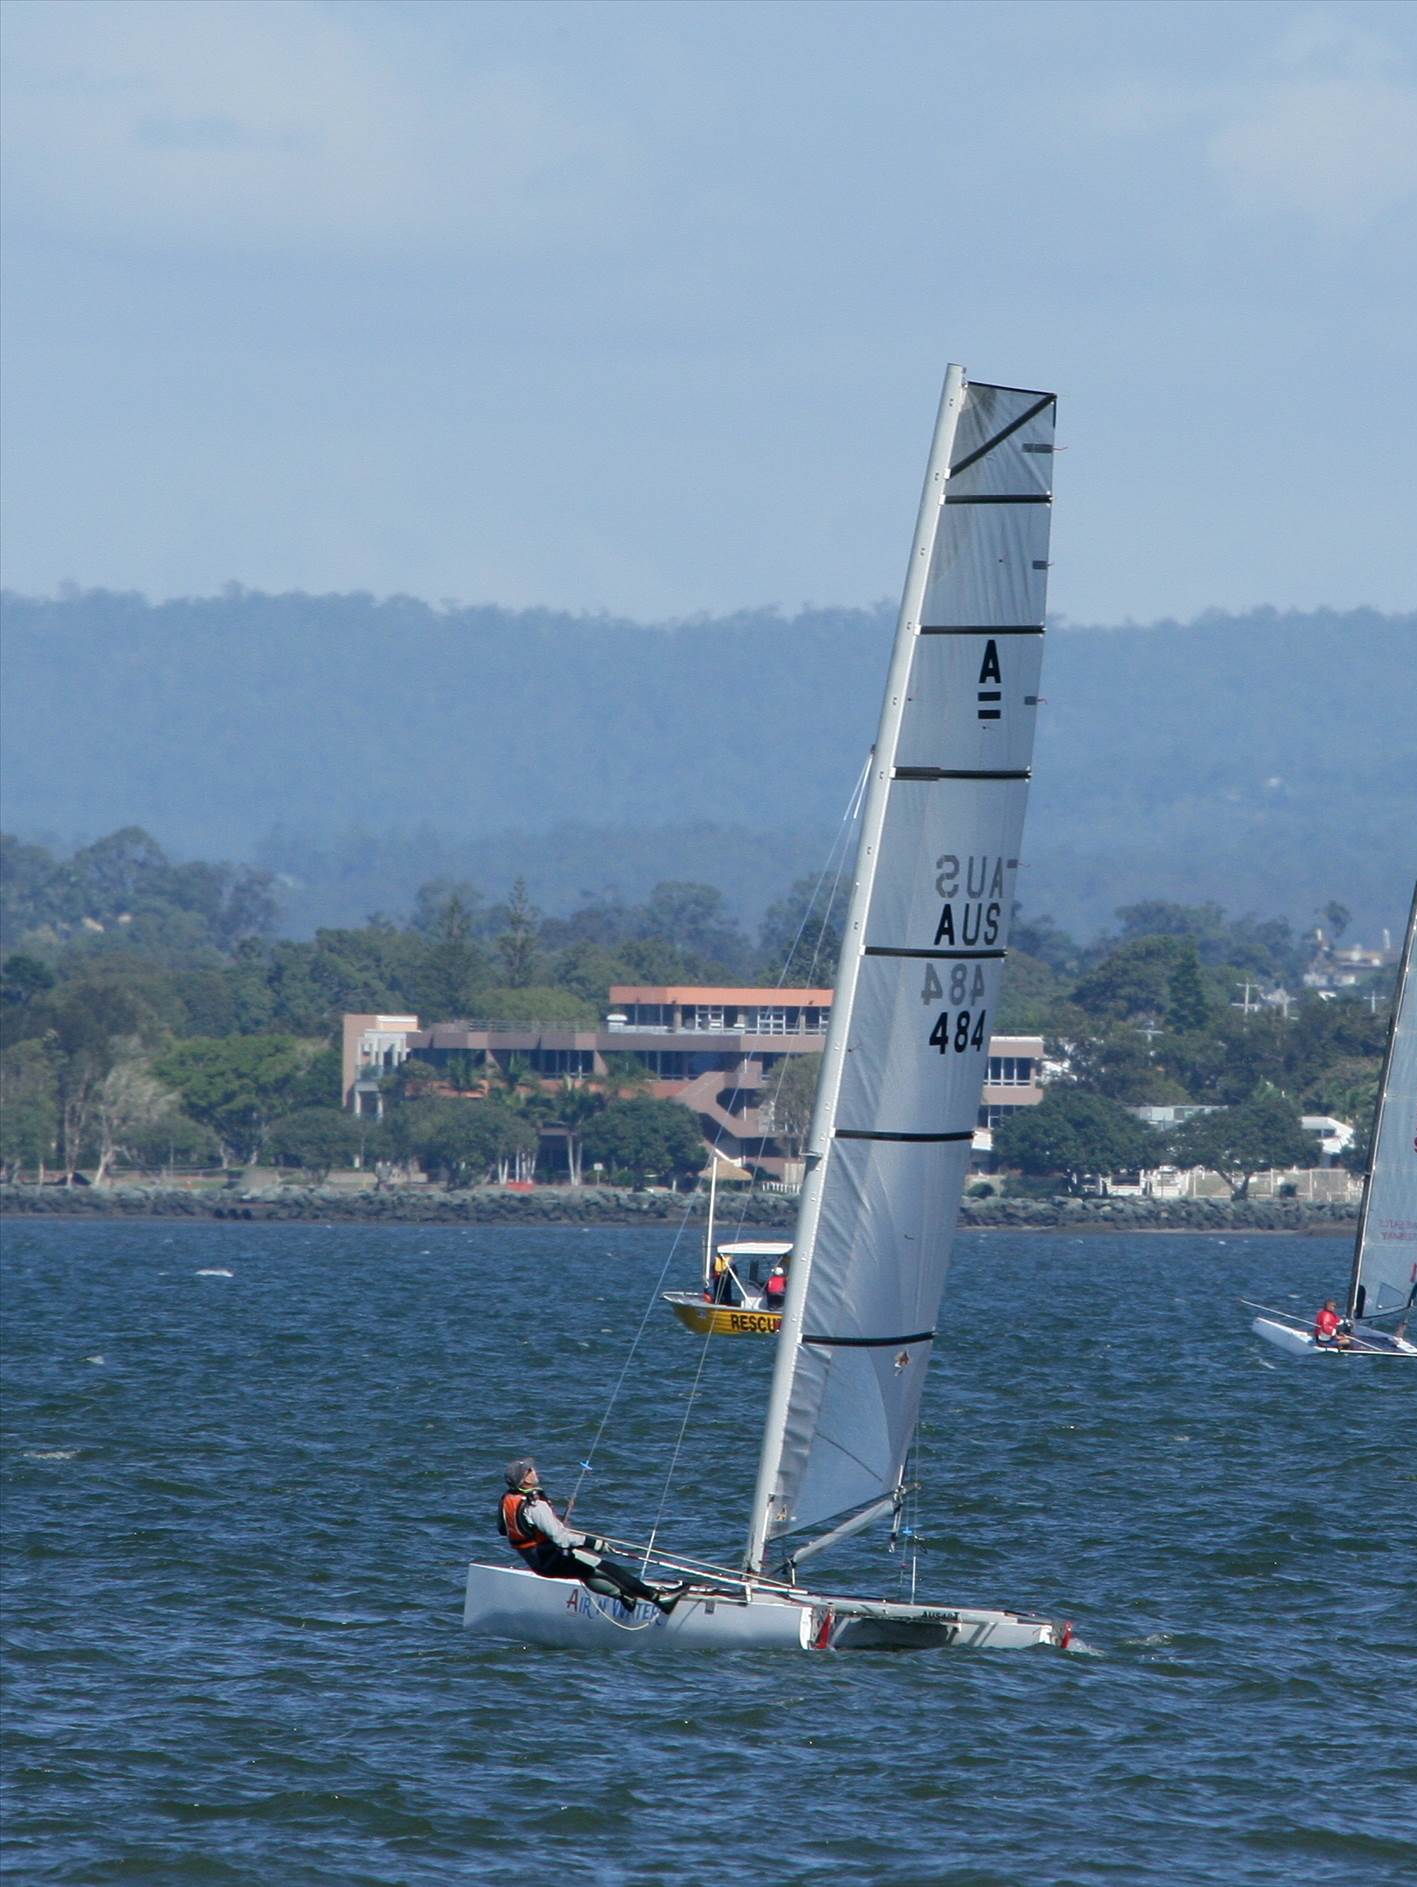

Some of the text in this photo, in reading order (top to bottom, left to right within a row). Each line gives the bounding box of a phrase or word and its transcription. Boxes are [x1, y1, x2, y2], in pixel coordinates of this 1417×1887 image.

[978, 639, 1002, 684] A
[933, 903, 1001, 946] AUS
[929, 1009, 987, 1055] 484
[730, 1314, 777, 1333] RESCU
